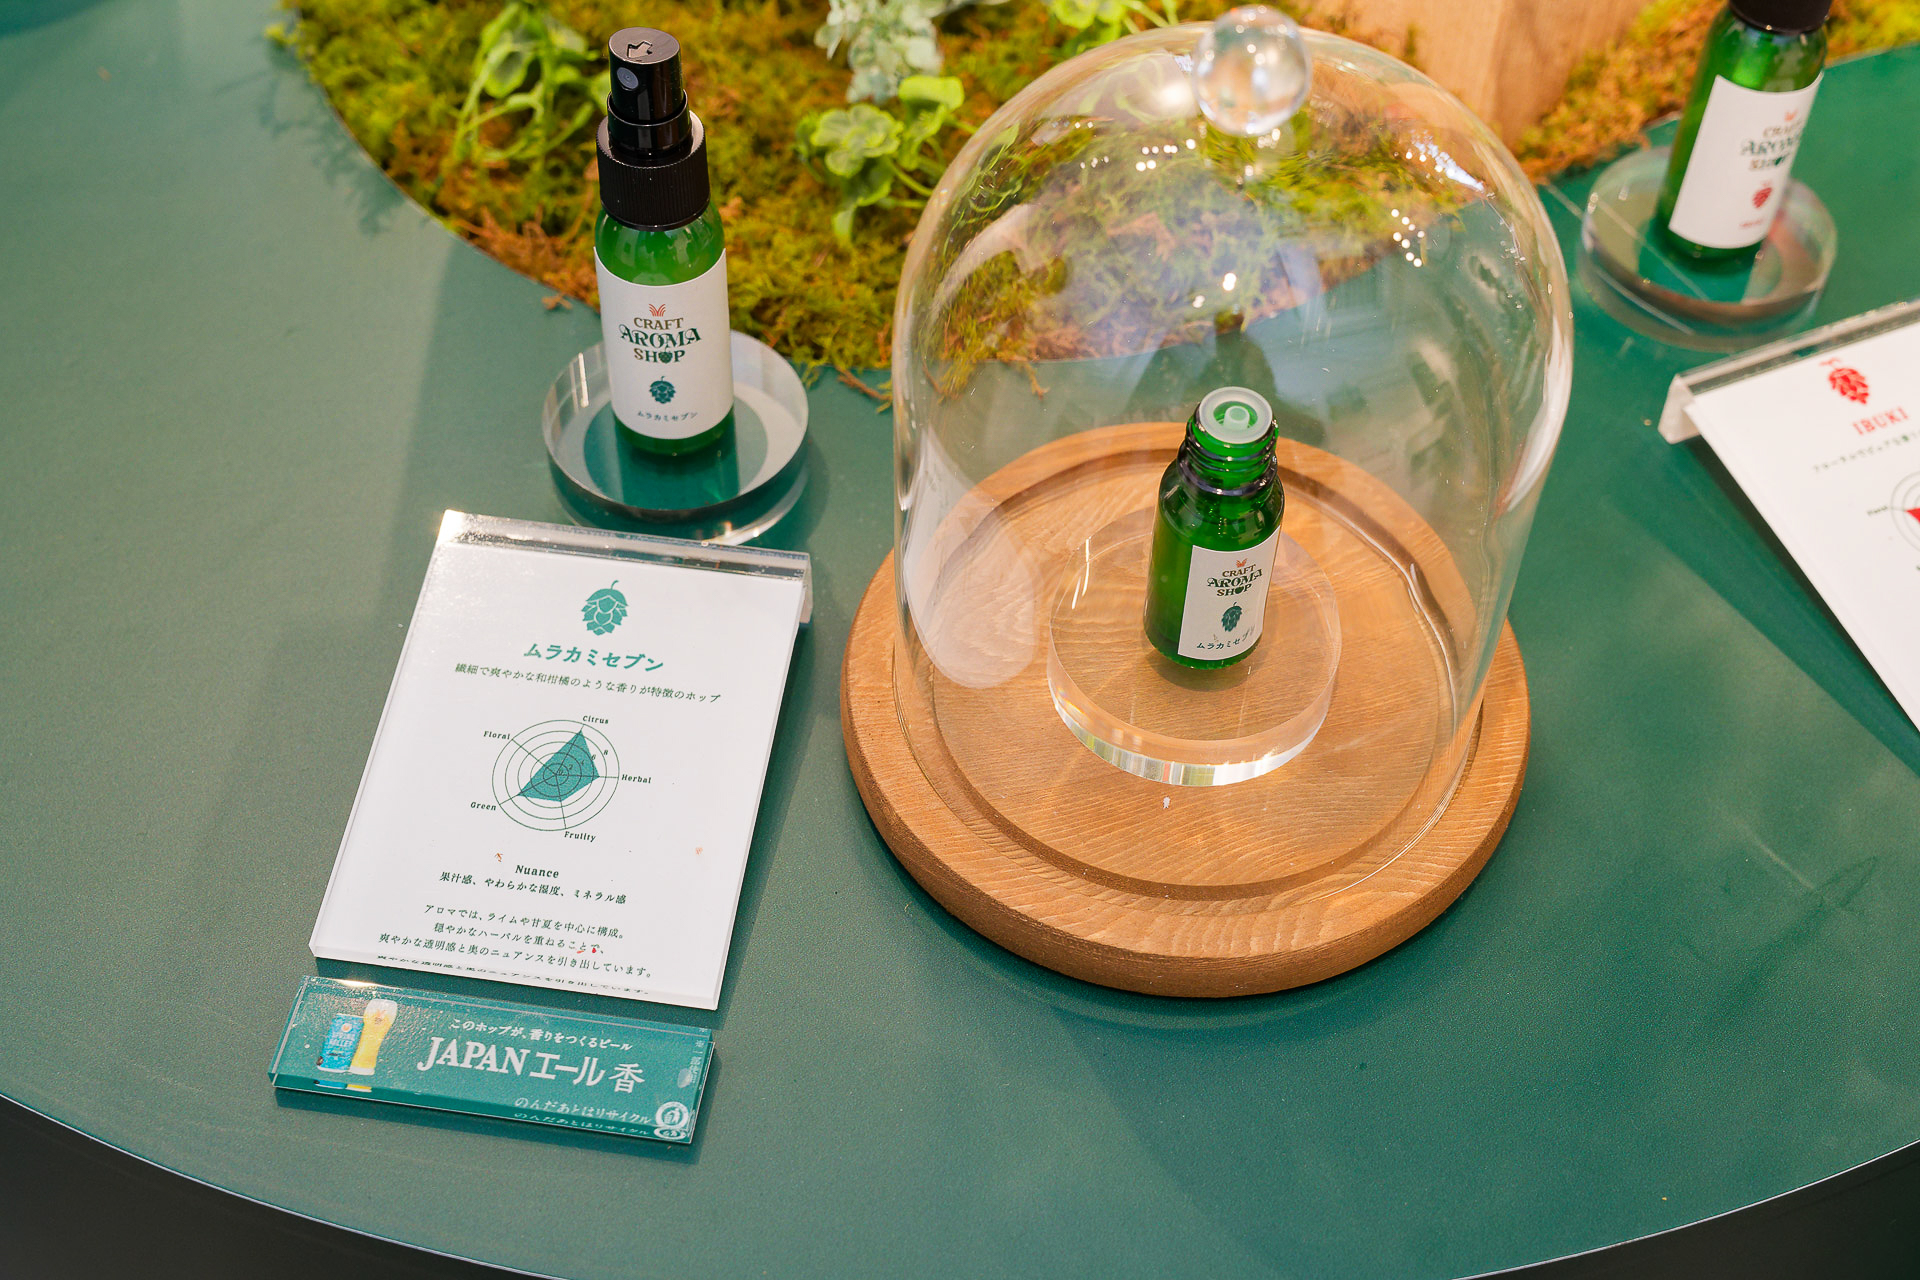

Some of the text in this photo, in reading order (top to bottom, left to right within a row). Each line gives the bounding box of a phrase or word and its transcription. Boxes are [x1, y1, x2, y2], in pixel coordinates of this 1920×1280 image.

[633, 317, 684, 330] CRAFT
[618, 323, 702, 349] AROMA
[633, 346, 686, 364] SHOP
[637, 410, 698, 422] ムラカミセブン
[1852, 406, 1909, 435] IBUKI
[1207, 568, 1263, 588] AROMA
[1222, 563, 1257, 578] CRAFT
[1216, 583, 1252, 597] SHOP
[524, 643, 664, 672] ムラカミセブン
[582, 715, 609, 725] Citrus
[483, 730, 511, 740] Floral
[621, 773, 652, 784] Herbal
[470, 801, 497, 811] Green
[515, 864, 560, 879] Nuance
[417, 1036, 530, 1075] JAPAN
